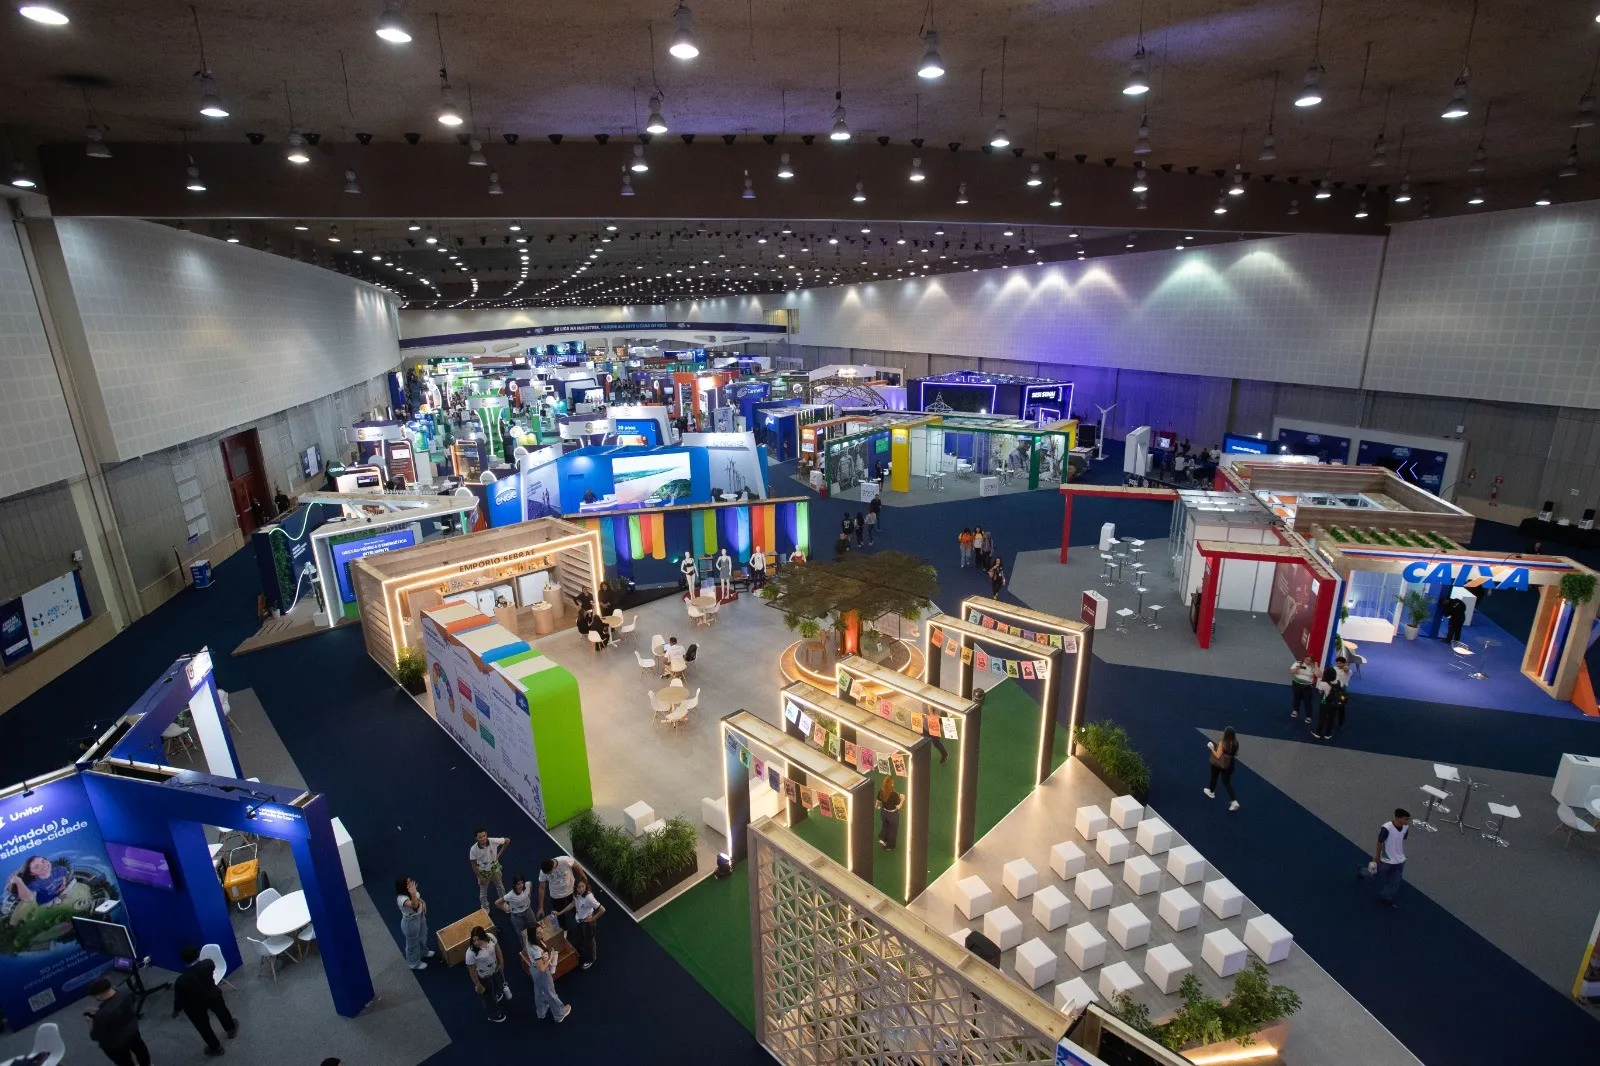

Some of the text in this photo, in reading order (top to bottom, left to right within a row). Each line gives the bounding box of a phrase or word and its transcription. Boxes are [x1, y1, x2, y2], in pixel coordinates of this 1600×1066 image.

[459, 549, 536, 573] EMPÓRIO SEBRAE
[1402, 561, 1529, 591] CAIXA
[9, 804, 44, 822] Unifor
